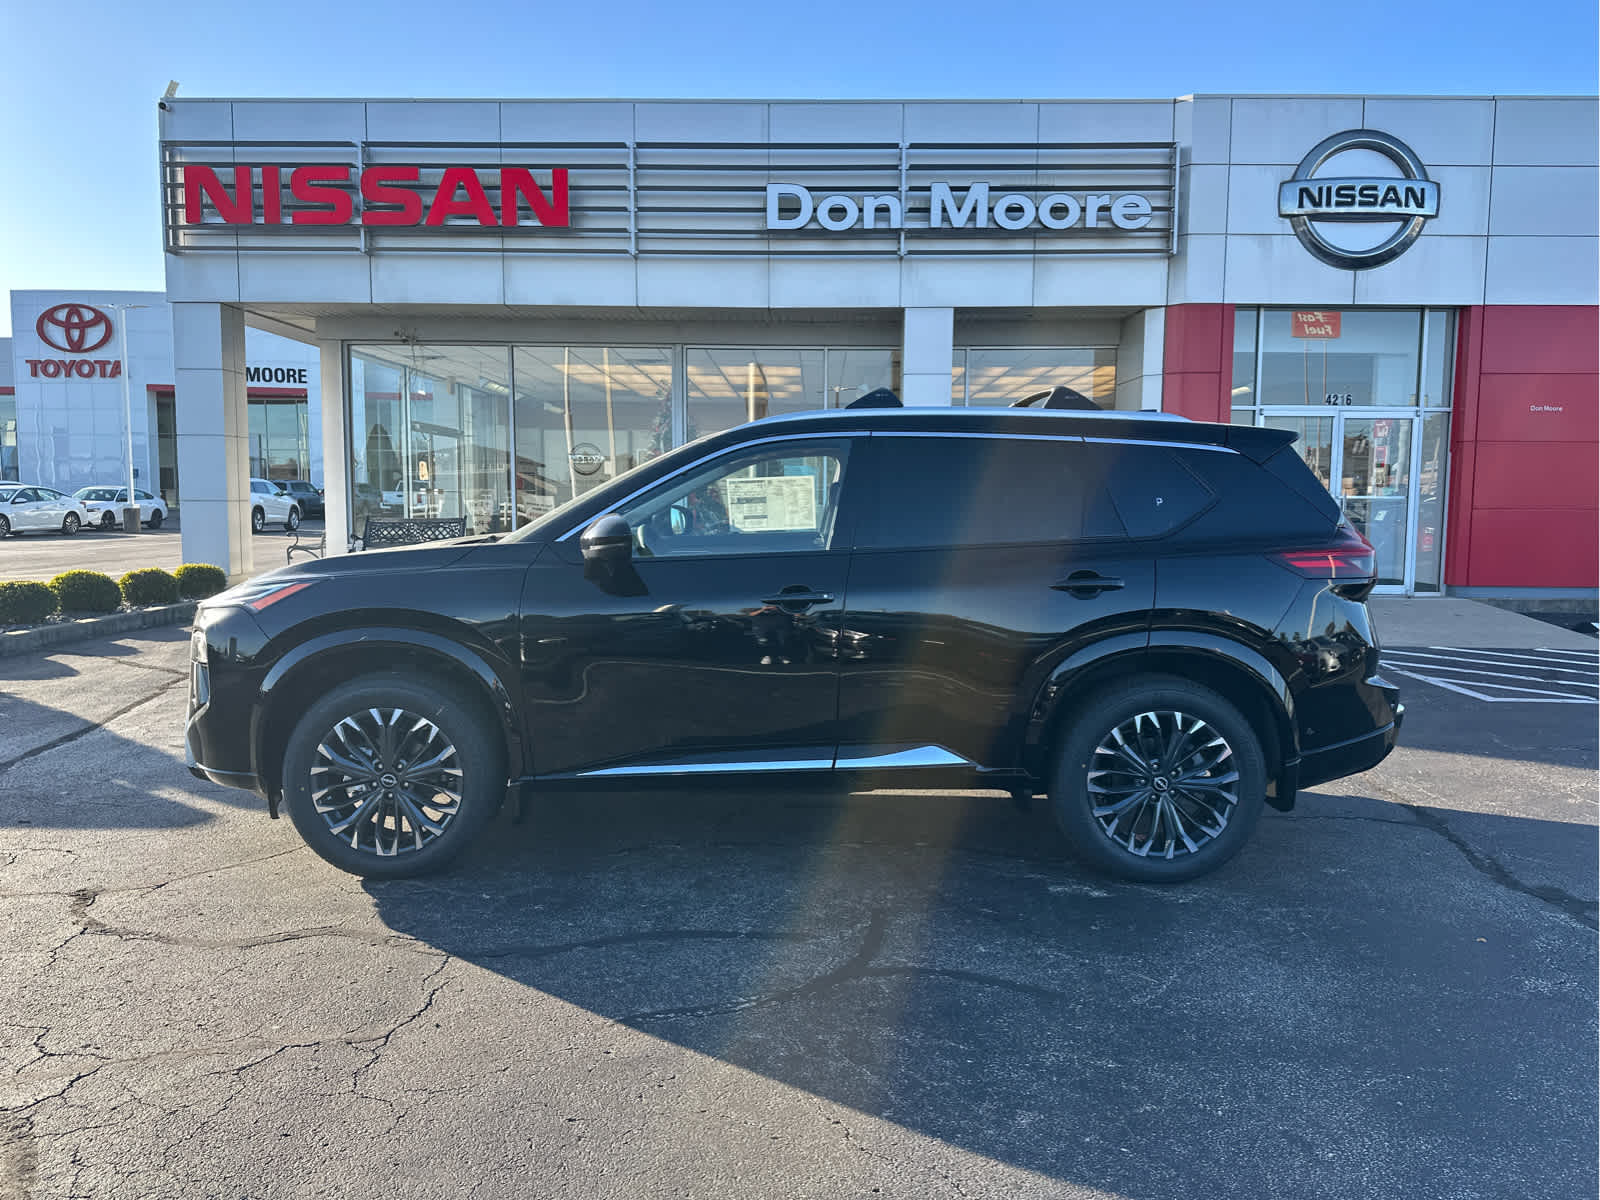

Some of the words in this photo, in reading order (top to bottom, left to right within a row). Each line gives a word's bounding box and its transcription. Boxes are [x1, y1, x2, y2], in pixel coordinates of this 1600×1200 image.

[184, 165, 569, 227] NISSAN
[766, 183, 901, 231] Don
[930, 182, 1153, 230] Moore
[1298, 185, 1425, 209] NISSAN
[25, 359, 122, 378] TOYOTA
[245, 367, 308, 384] MOORE
[1326, 394, 1352, 406] 4216
